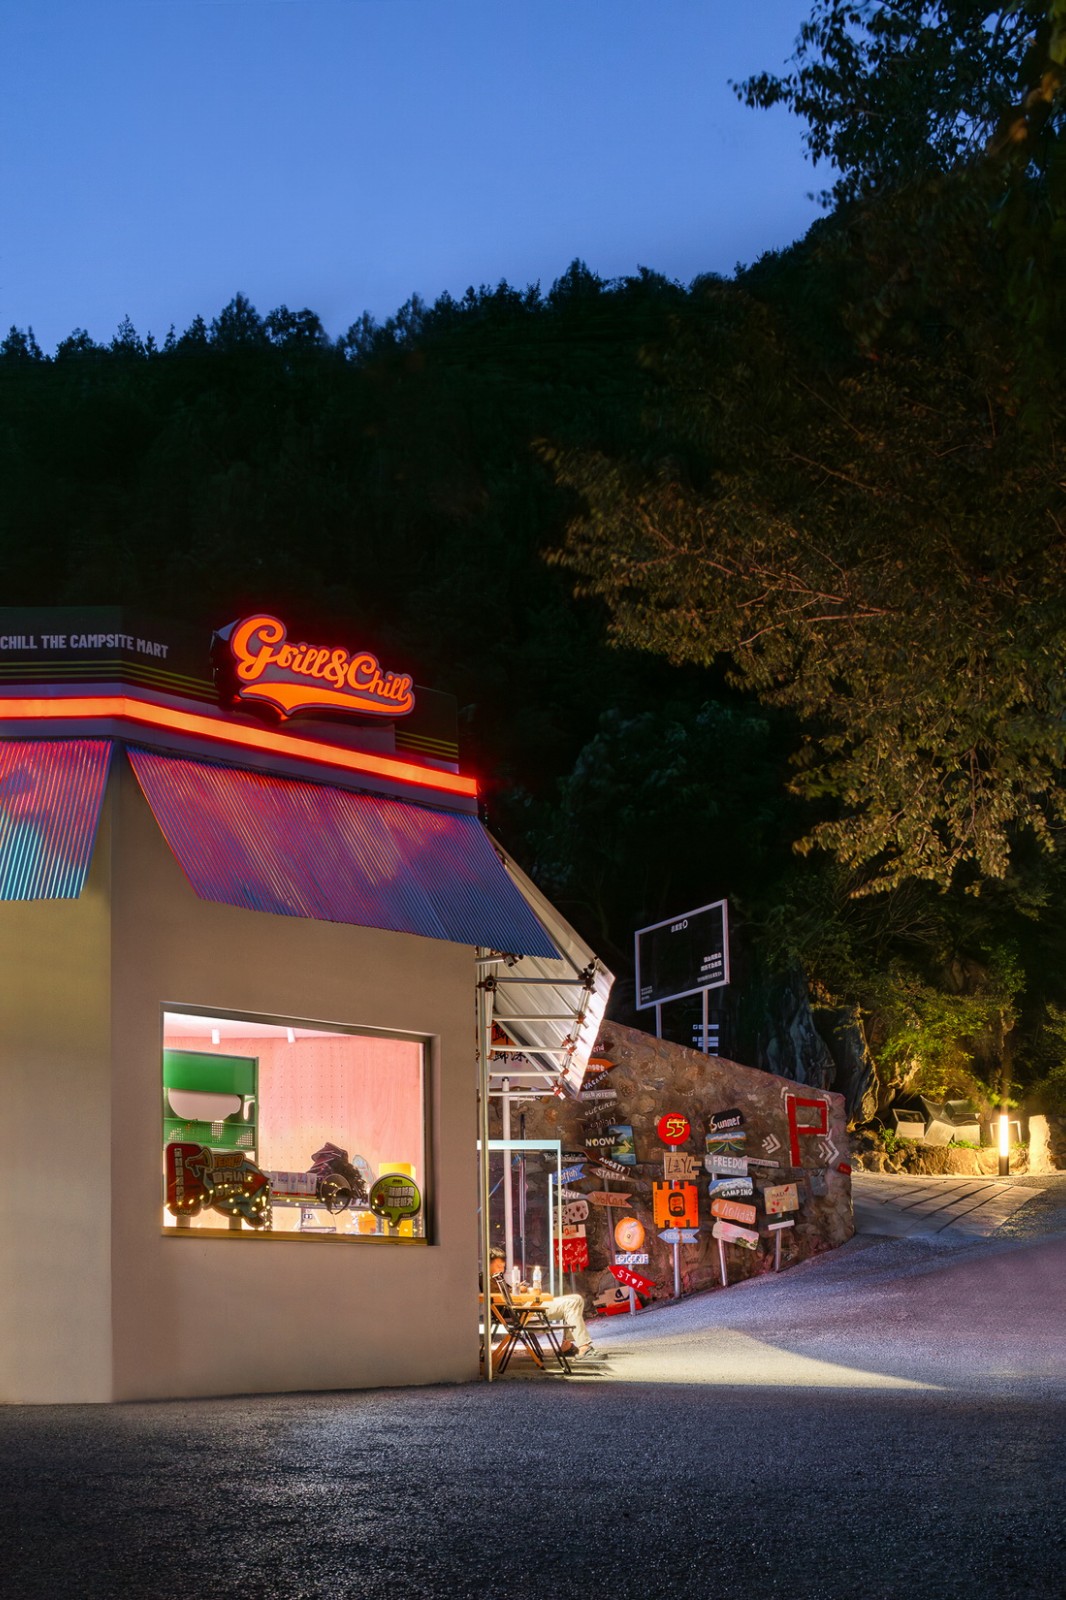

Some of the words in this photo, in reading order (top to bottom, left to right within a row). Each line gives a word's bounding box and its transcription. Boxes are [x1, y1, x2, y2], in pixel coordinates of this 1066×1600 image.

[0, 635, 37, 650] CHILL
[41, 634, 67, 649] THE
[70, 633, 135, 651] CAMPSITE
[136, 638, 169, 660] MART
[232, 614, 414, 709] Grill&Chill
[711, 1114, 741, 1132] Summer
[712, 1155, 748, 1170] FREEDOM
[721, 1186, 754, 1198] CAMPING
